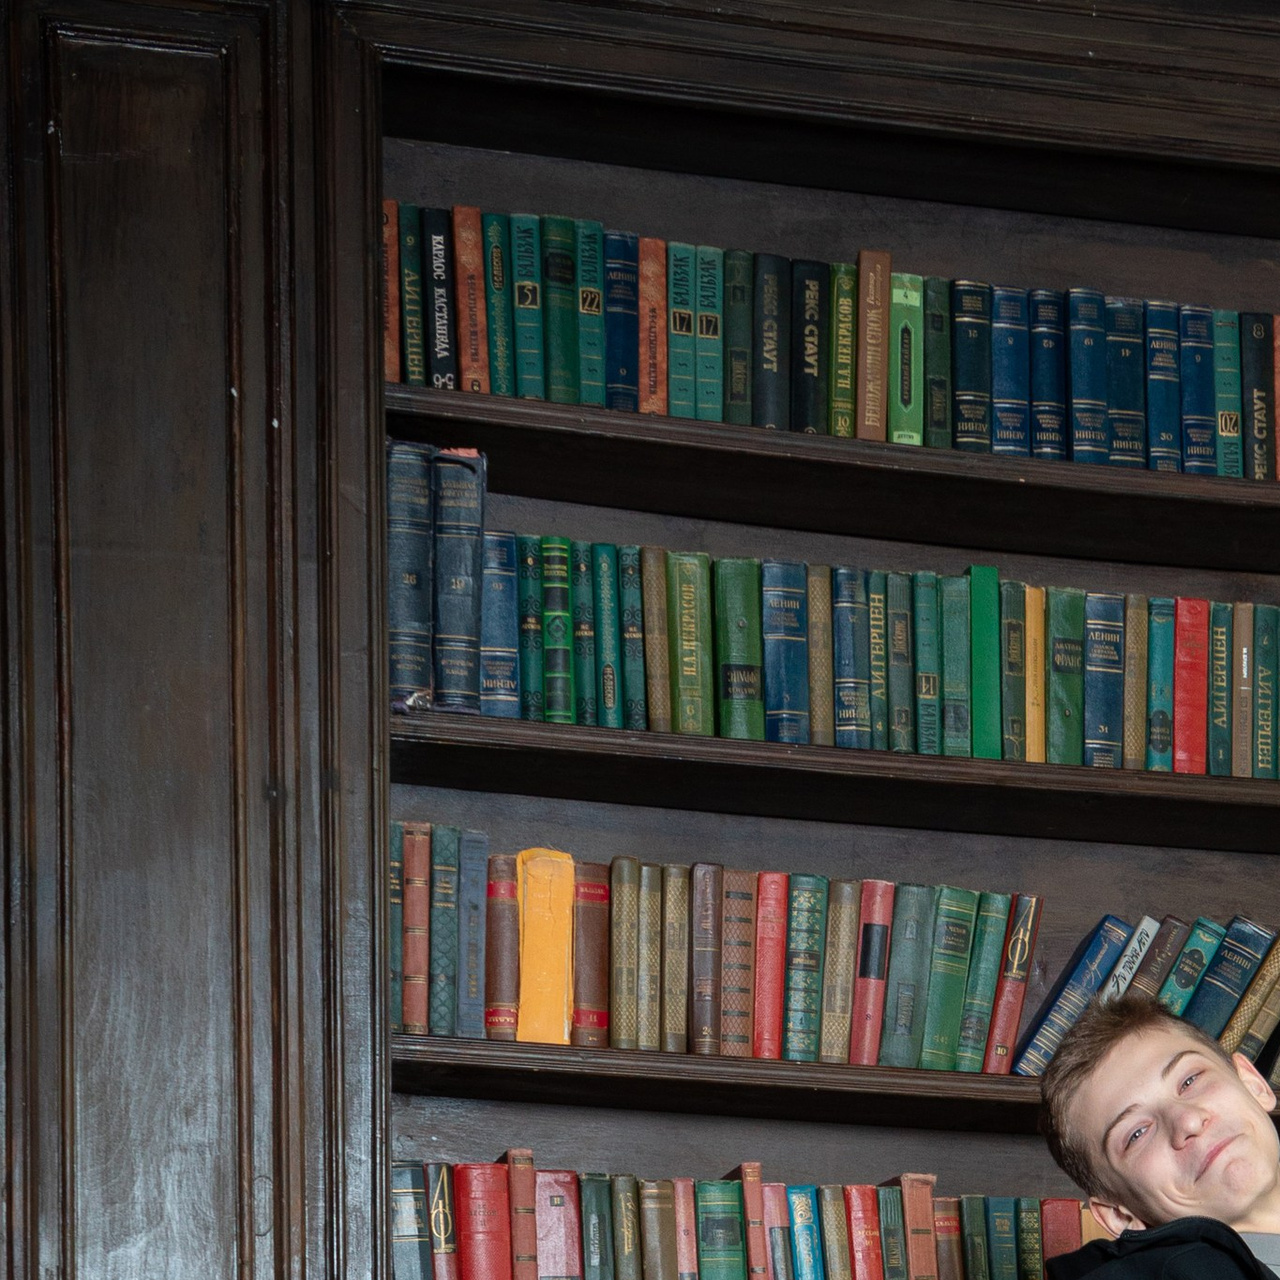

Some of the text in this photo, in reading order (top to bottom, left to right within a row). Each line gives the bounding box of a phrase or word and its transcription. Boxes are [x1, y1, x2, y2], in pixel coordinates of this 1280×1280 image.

[516, 225, 535, 279] БАЛЬЗАК
[580, 232, 598, 285] БАЛЬЗАК
[607, 271, 636, 283] ЛЕНИН
[673, 254, 690, 307] БАЛЬЗАК
[700, 256, 716, 309] БАЛЬЗАК
[431, 234, 451, 359] КАРЛОС КАСТАНЕДА
[522, 287, 533, 306] 5
[582, 290, 599, 312] 22
[674, 312, 689, 332] 17
[700, 316, 716, 336] 17
[762, 273, 779, 373] РЕКС СТАУТ
[803, 278, 819, 377] РЕКС СТАУТ
[1252, 323, 1265, 338] 8
[1150, 340, 1178, 351] ЛЕНИН
[864, 308, 883, 428] БЕНДЖАМИН СПОК
[837, 416, 850, 427] 10
[1221, 413, 1239, 433] 20
[1253, 387, 1268, 440] СТАУТ
[957, 421, 988, 433] ЛЕНИН
[996, 430, 1026, 440] ЛЕНИН
[1036, 431, 1062, 442] ЛЕНИН
[1074, 429, 1107, 441] ЛЕНИН
[1112, 439, 1144, 451] ЛЕНИН
[1187, 446, 1215, 456] ЛЕНИН
[1222, 442, 1240, 478] БАЛЬЗ
[769, 599, 801, 610] ЛЕНИН
[870, 593, 886, 701] А.И.ГЕРЦЕН
[1088, 633, 1120, 643] ЛЕНИН
[1053, 653, 1082, 667] ФРАНС
[482, 679, 517, 690] ЛЕНИН
[919, 676, 938, 695] 14
[1213, 626, 1228, 729] А.И.ГЕРЦЕН
[1257, 665, 1273, 770] А.И.ГЕРЦЕН
[1220, 949, 1253, 970] ЛЕНИН
